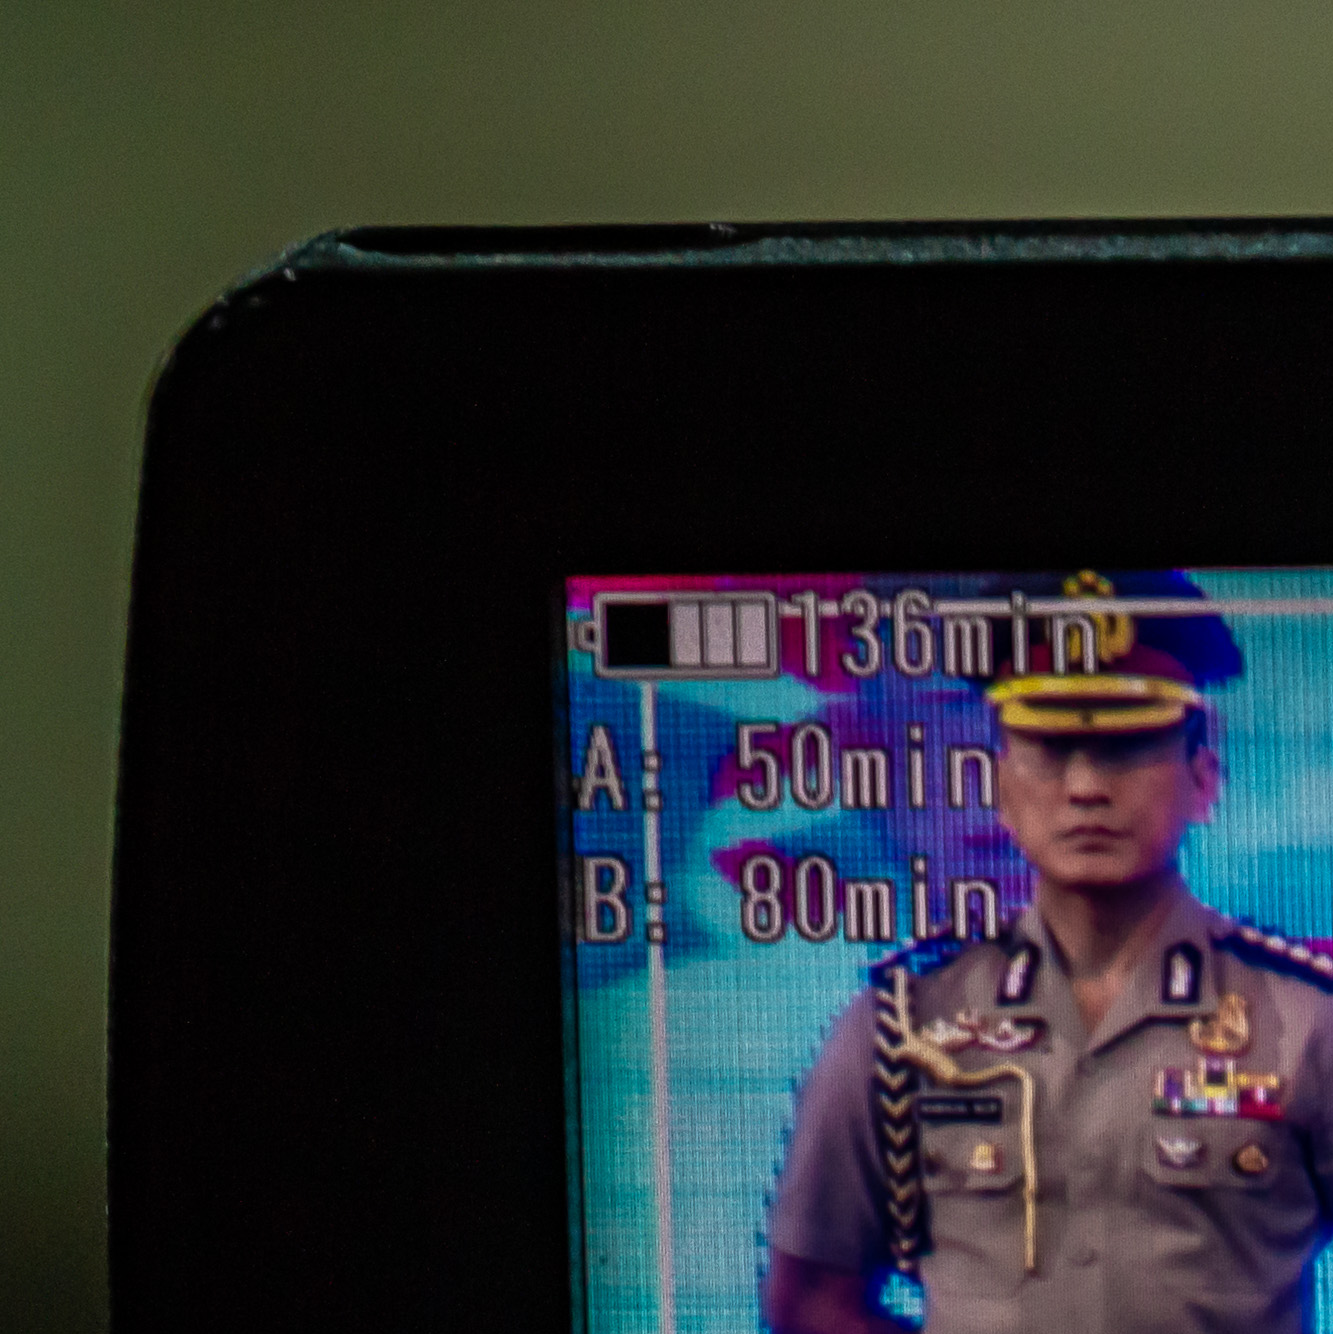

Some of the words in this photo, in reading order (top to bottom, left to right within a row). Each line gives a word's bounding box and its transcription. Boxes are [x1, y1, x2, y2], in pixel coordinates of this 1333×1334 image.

[797, 588, 1099, 677] 136min
[735, 722, 995, 811] 50min
[740, 855, 1000, 943] 80min
